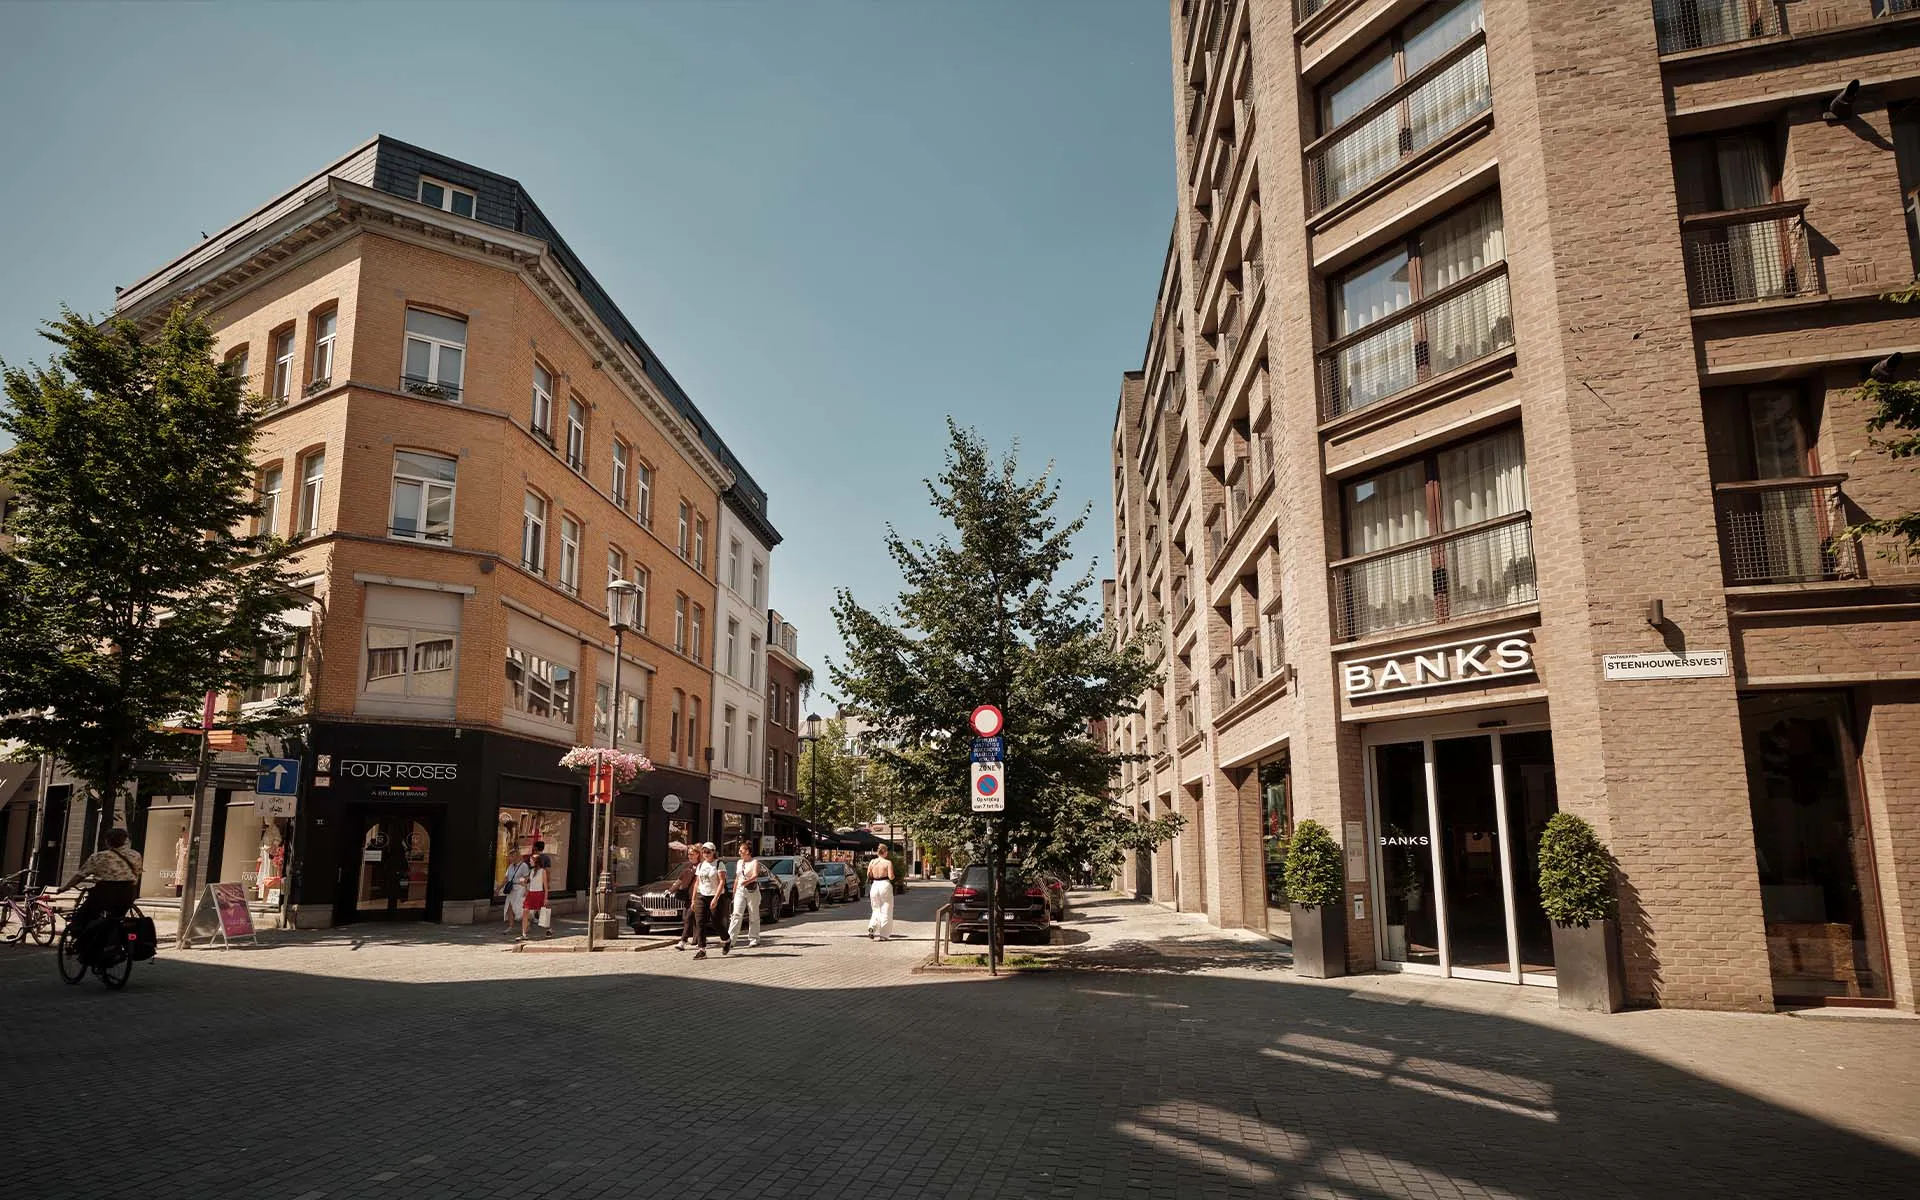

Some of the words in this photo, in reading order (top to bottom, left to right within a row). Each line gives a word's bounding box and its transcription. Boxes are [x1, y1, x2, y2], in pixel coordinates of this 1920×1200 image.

[1344, 638, 1533, 692] BANKS
[1607, 657, 1725, 670] STEENHOUWERSVEST
[340, 760, 391, 778] FOUR
[396, 764, 457, 780] ROSES
[1379, 836, 1428, 846] BANKS
